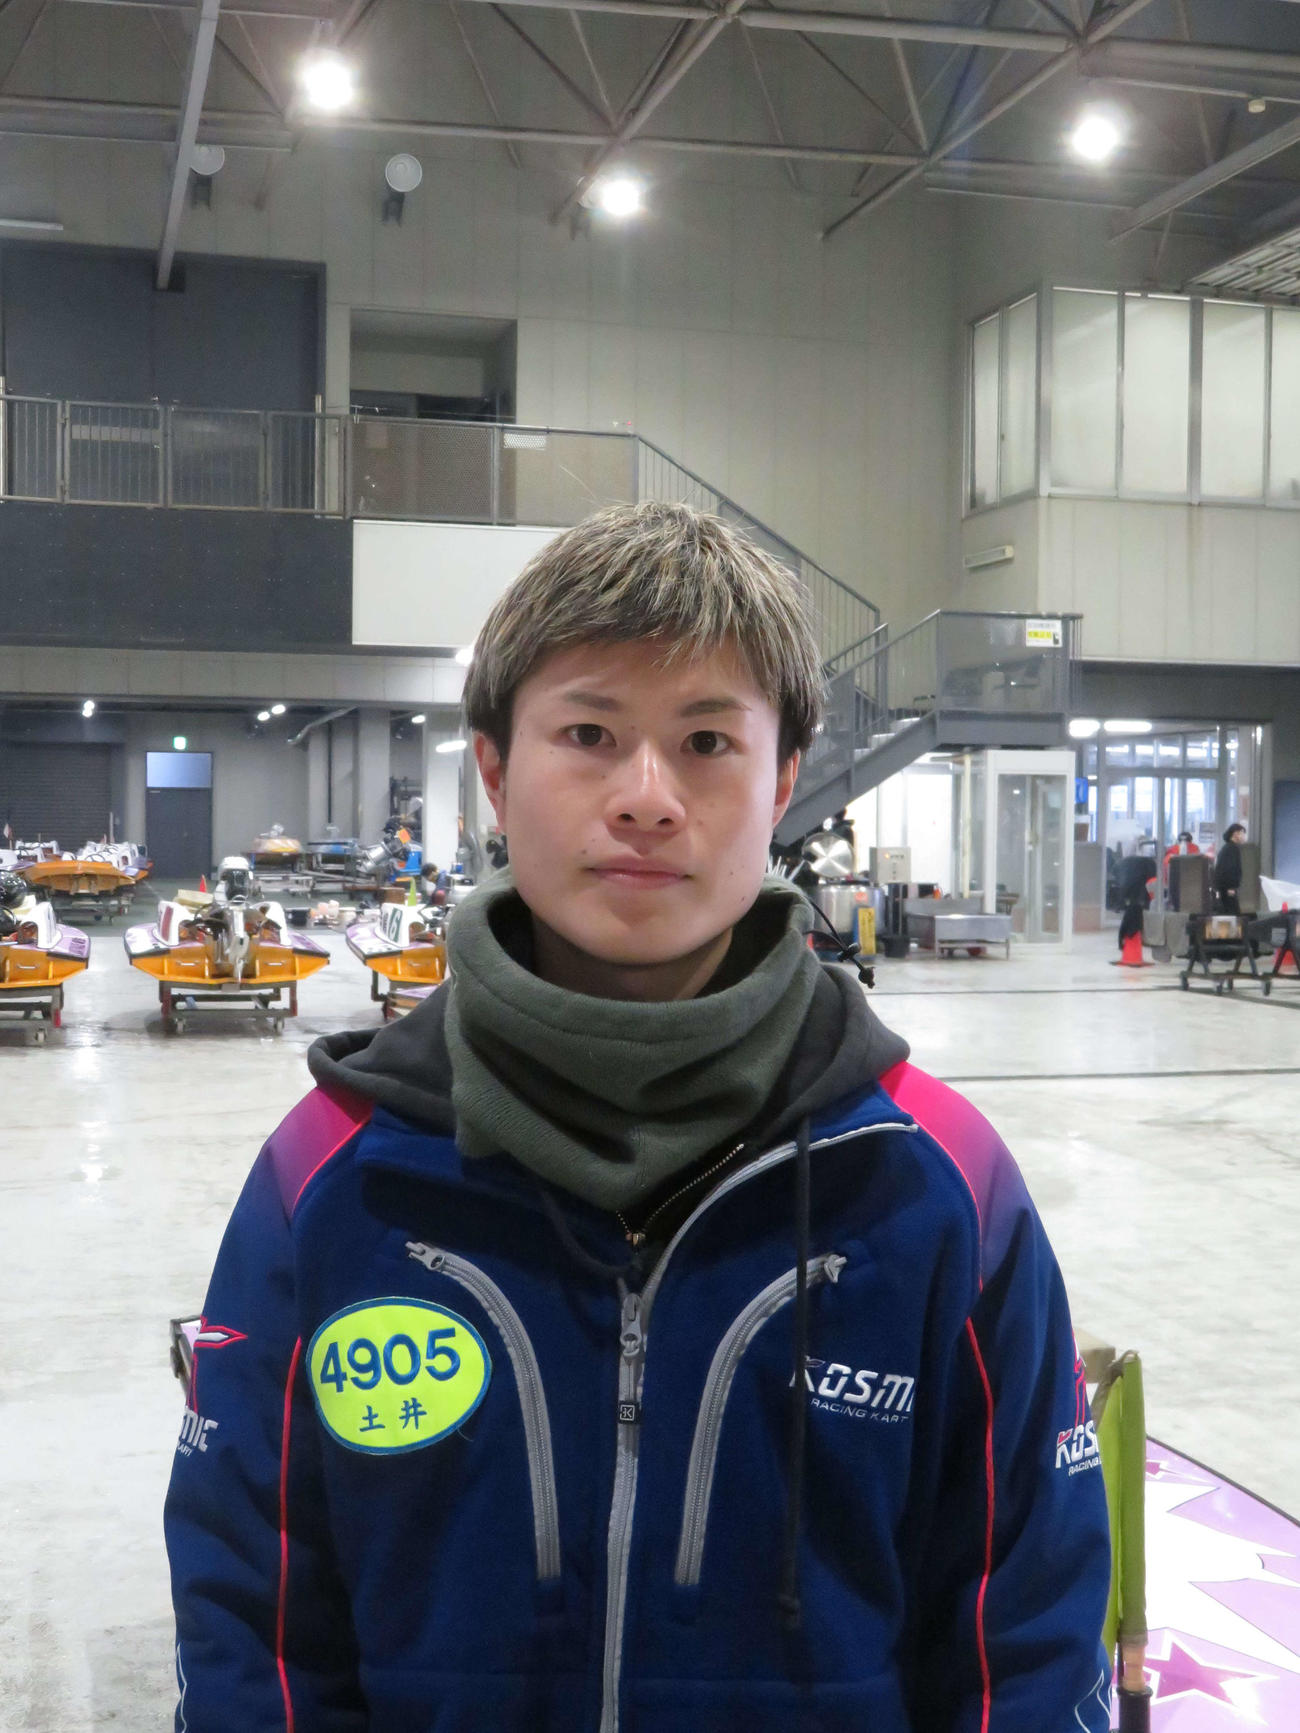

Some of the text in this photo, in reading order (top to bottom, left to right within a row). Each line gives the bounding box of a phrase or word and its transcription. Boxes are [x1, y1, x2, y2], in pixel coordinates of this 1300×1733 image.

[320, 1327, 461, 1393] 4905
[359, 1397, 427, 1432] 土井
[810, 1398, 868, 1418] RACING
[870, 1411, 909, 1424] KART
[1055, 1420, 1100, 1469] KOS
